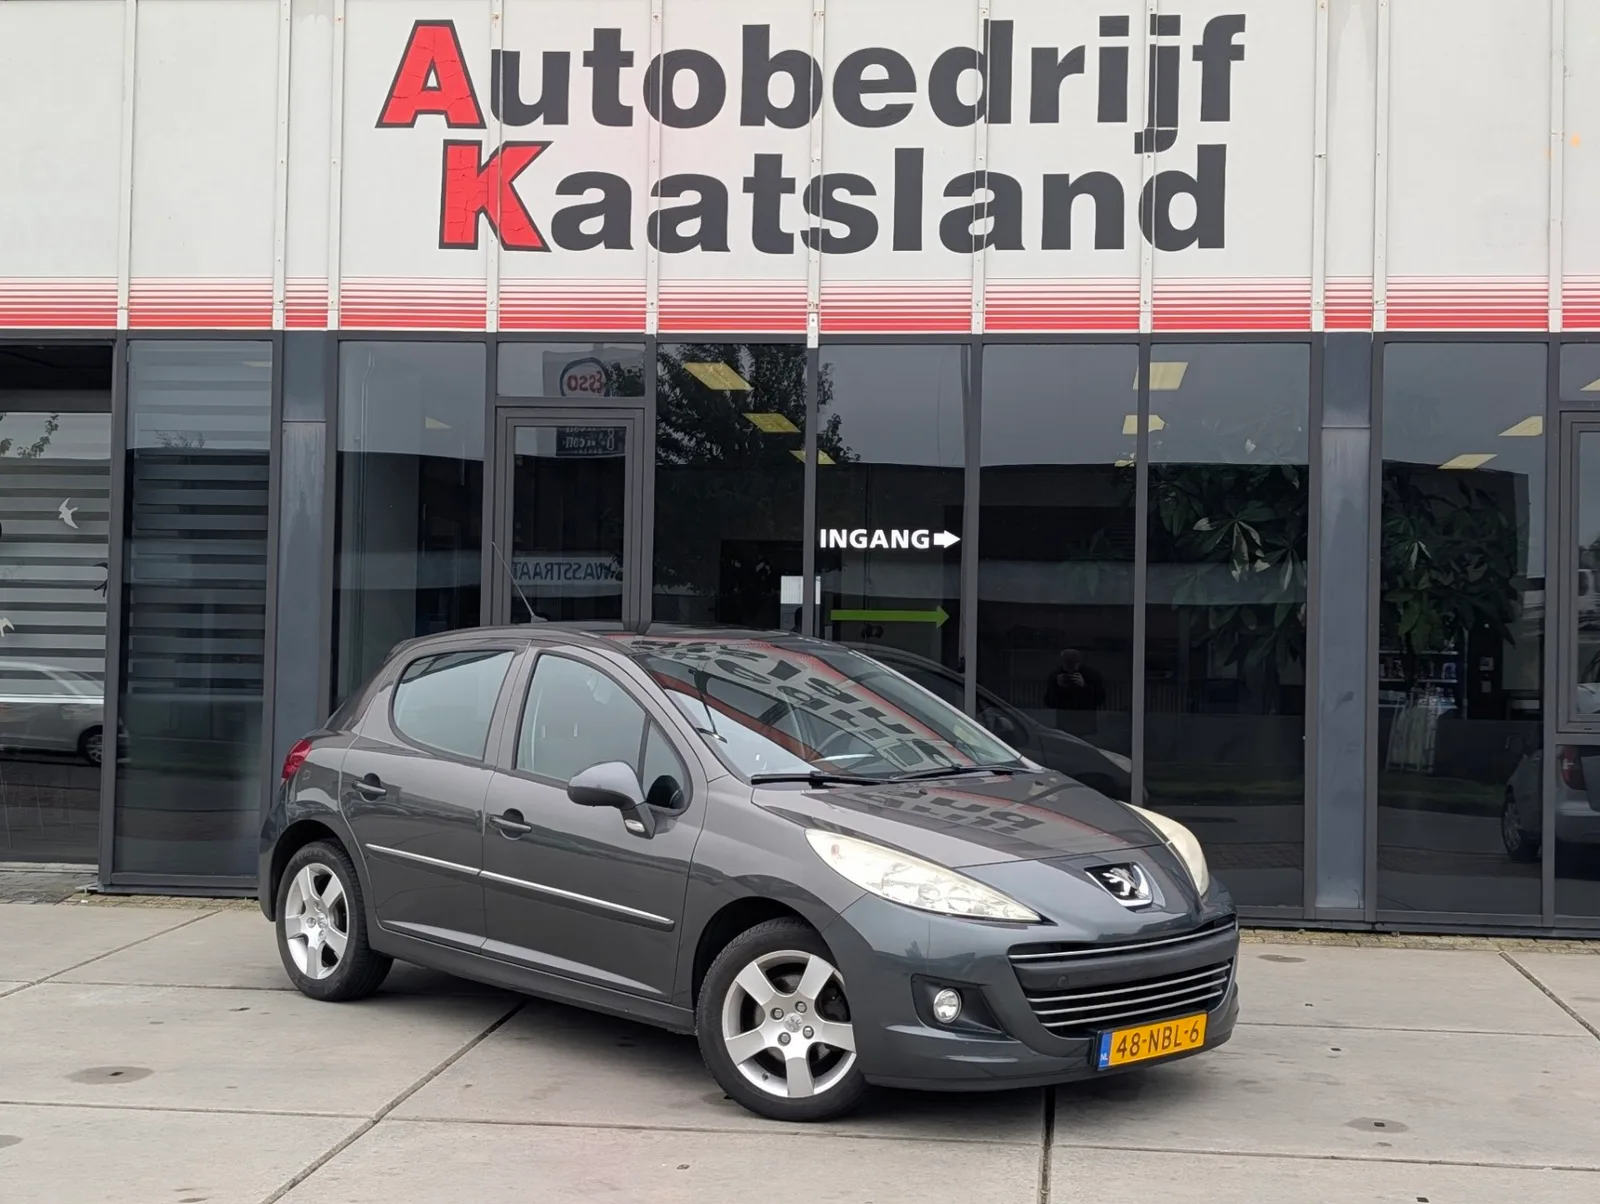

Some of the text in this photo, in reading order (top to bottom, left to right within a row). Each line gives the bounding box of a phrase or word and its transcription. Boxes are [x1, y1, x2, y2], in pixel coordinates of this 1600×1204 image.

[375, 14, 1246, 154] Autobedrijf
[438, 139, 1227, 254] Kaatsland
[819, 528, 930, 549] INGANG
[1115, 1020, 1199, 1058] 48-NBL-6
